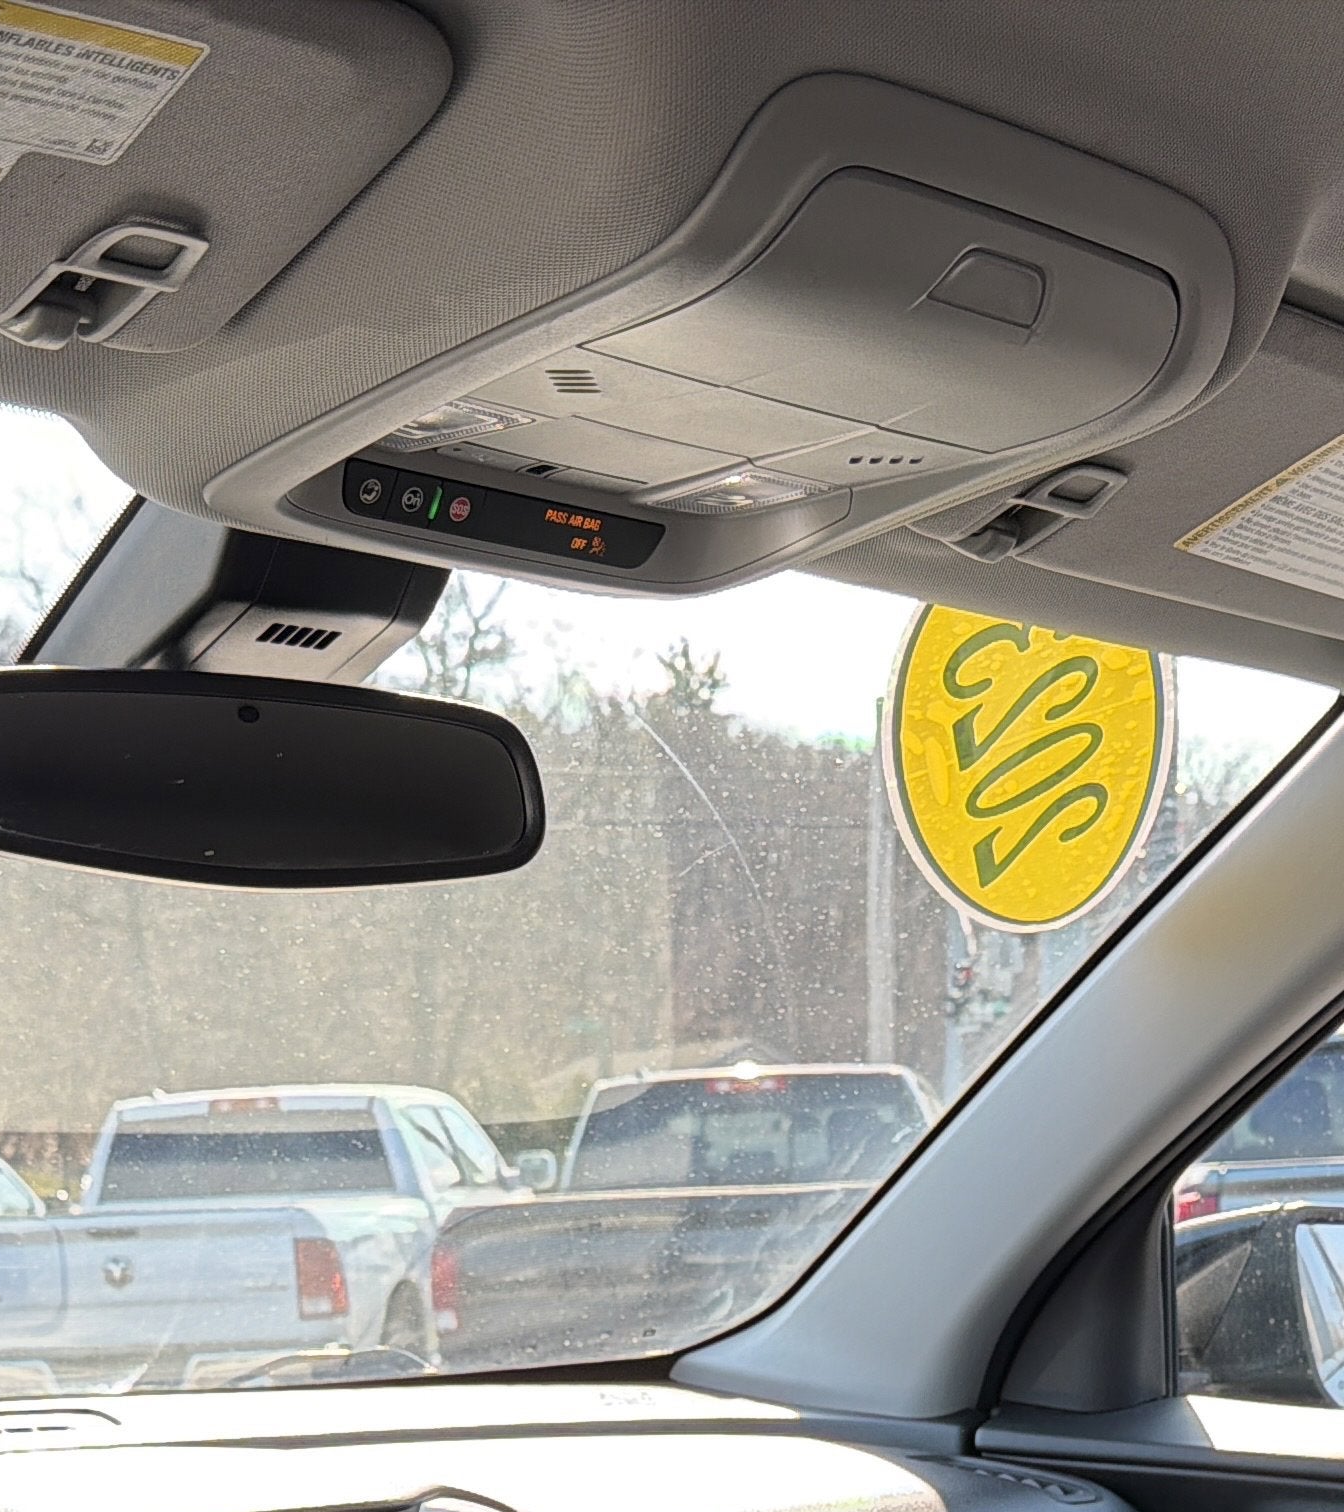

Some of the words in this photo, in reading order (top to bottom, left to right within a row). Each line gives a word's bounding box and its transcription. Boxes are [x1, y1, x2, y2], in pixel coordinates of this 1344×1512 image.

[76, 47, 179, 81] INTELLIGENTS
[545, 508, 568, 525] PASS
[568, 513, 583, 528] AIR
[584, 517, 602, 532] BAG
[570, 537, 588, 550] OFF
